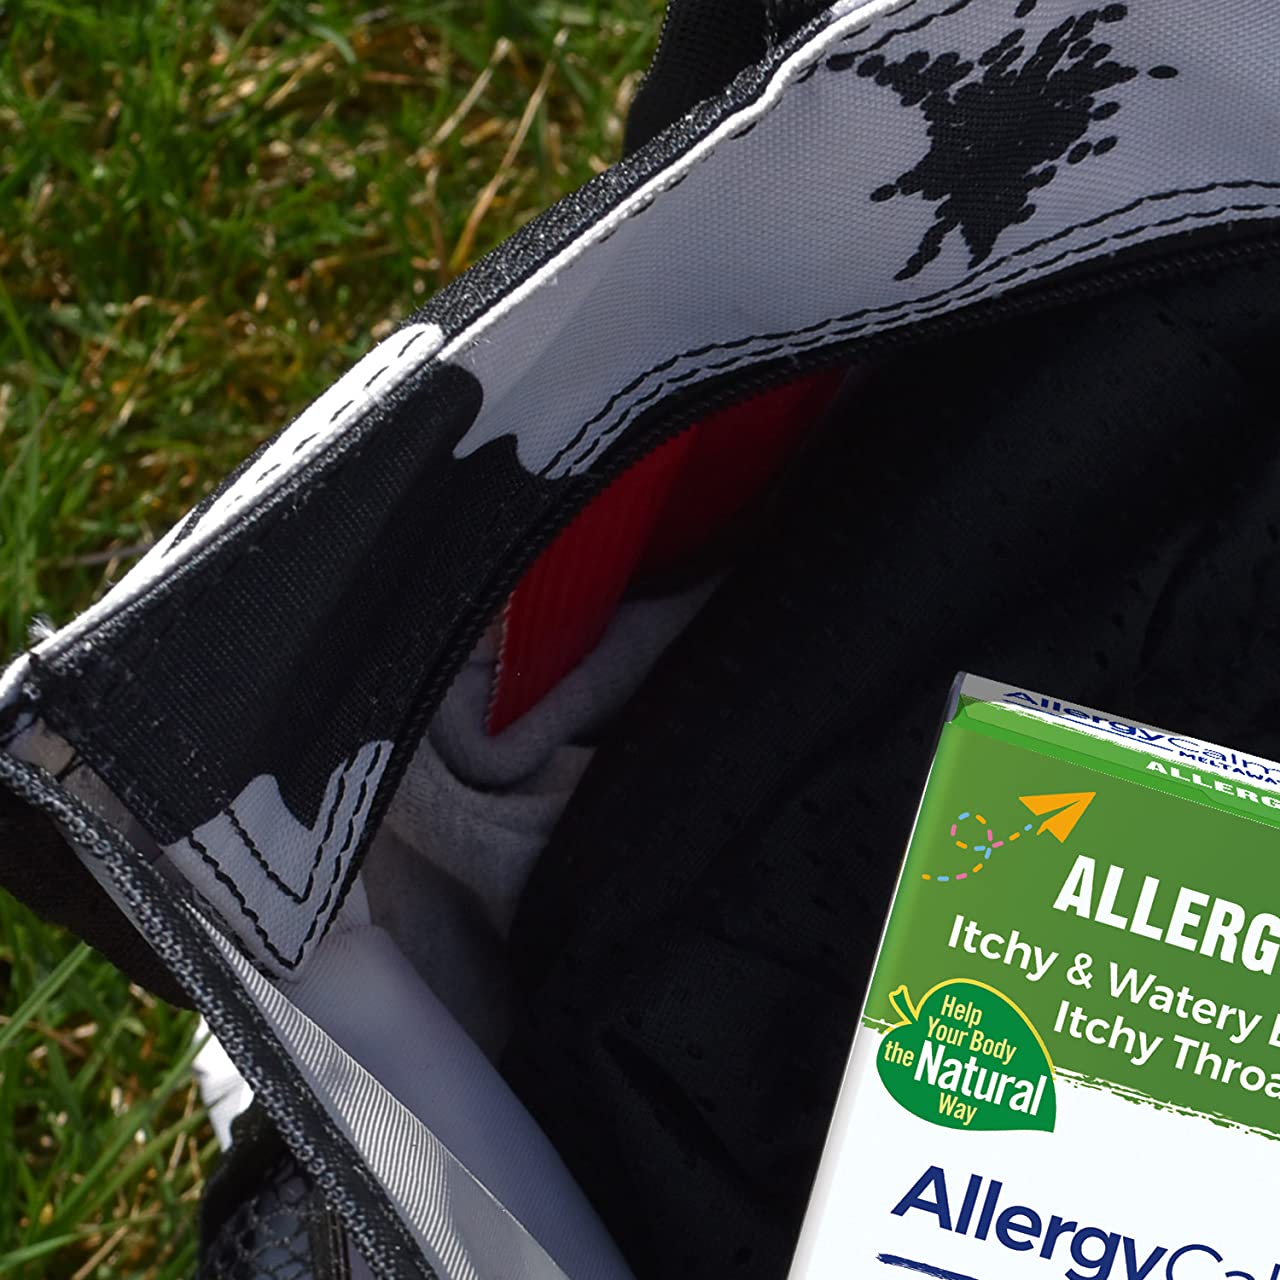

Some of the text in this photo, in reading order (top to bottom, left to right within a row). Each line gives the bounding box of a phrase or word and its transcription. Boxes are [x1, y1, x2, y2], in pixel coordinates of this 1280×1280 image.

[949, 914, 1058, 981] Itchy
[1065, 952, 1093, 988] &
[1109, 960, 1260, 1042] Watery
[940, 994, 982, 1028] Help
[1052, 999, 1160, 1066] Itchy
[927, 1016, 1017, 1065] Your Body
[883, 1039, 1047, 1116] the Natural
[938, 1092, 977, 1126] Way
